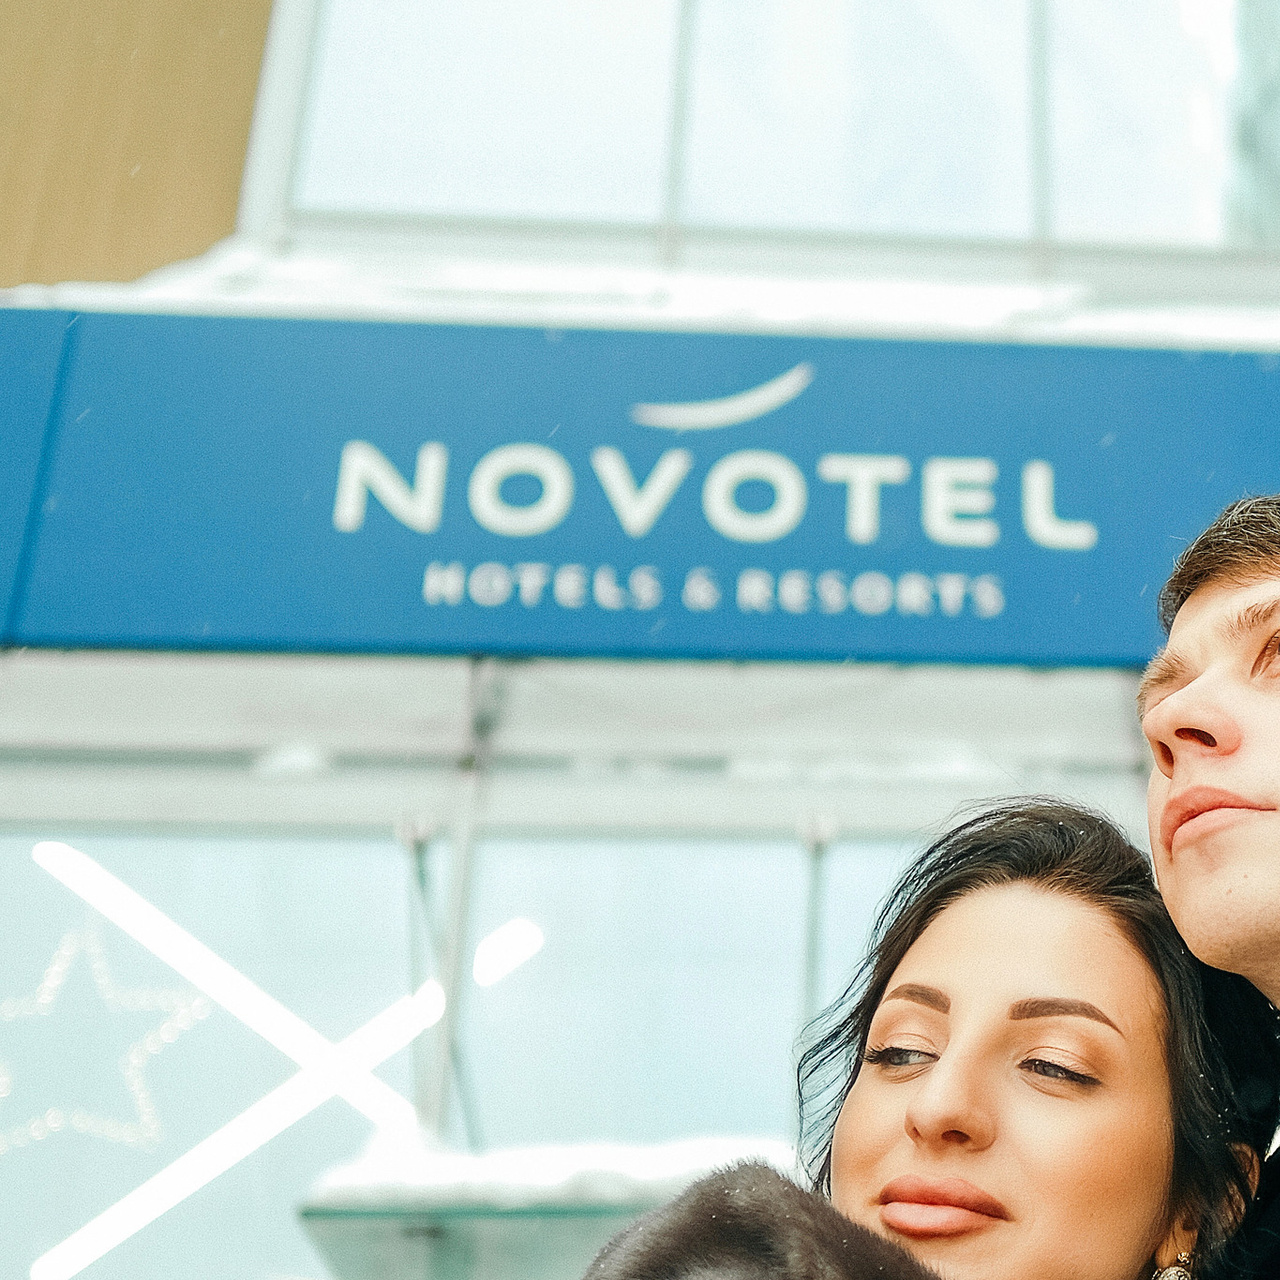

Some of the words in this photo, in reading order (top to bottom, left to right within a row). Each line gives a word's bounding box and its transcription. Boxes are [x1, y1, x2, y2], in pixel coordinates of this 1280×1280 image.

[332, 439, 1099, 552] NOVOTEL
[422, 560, 664, 612] HOTELS
[682, 566, 721, 613] &
[735, 568, 1005, 619] RESORTS
